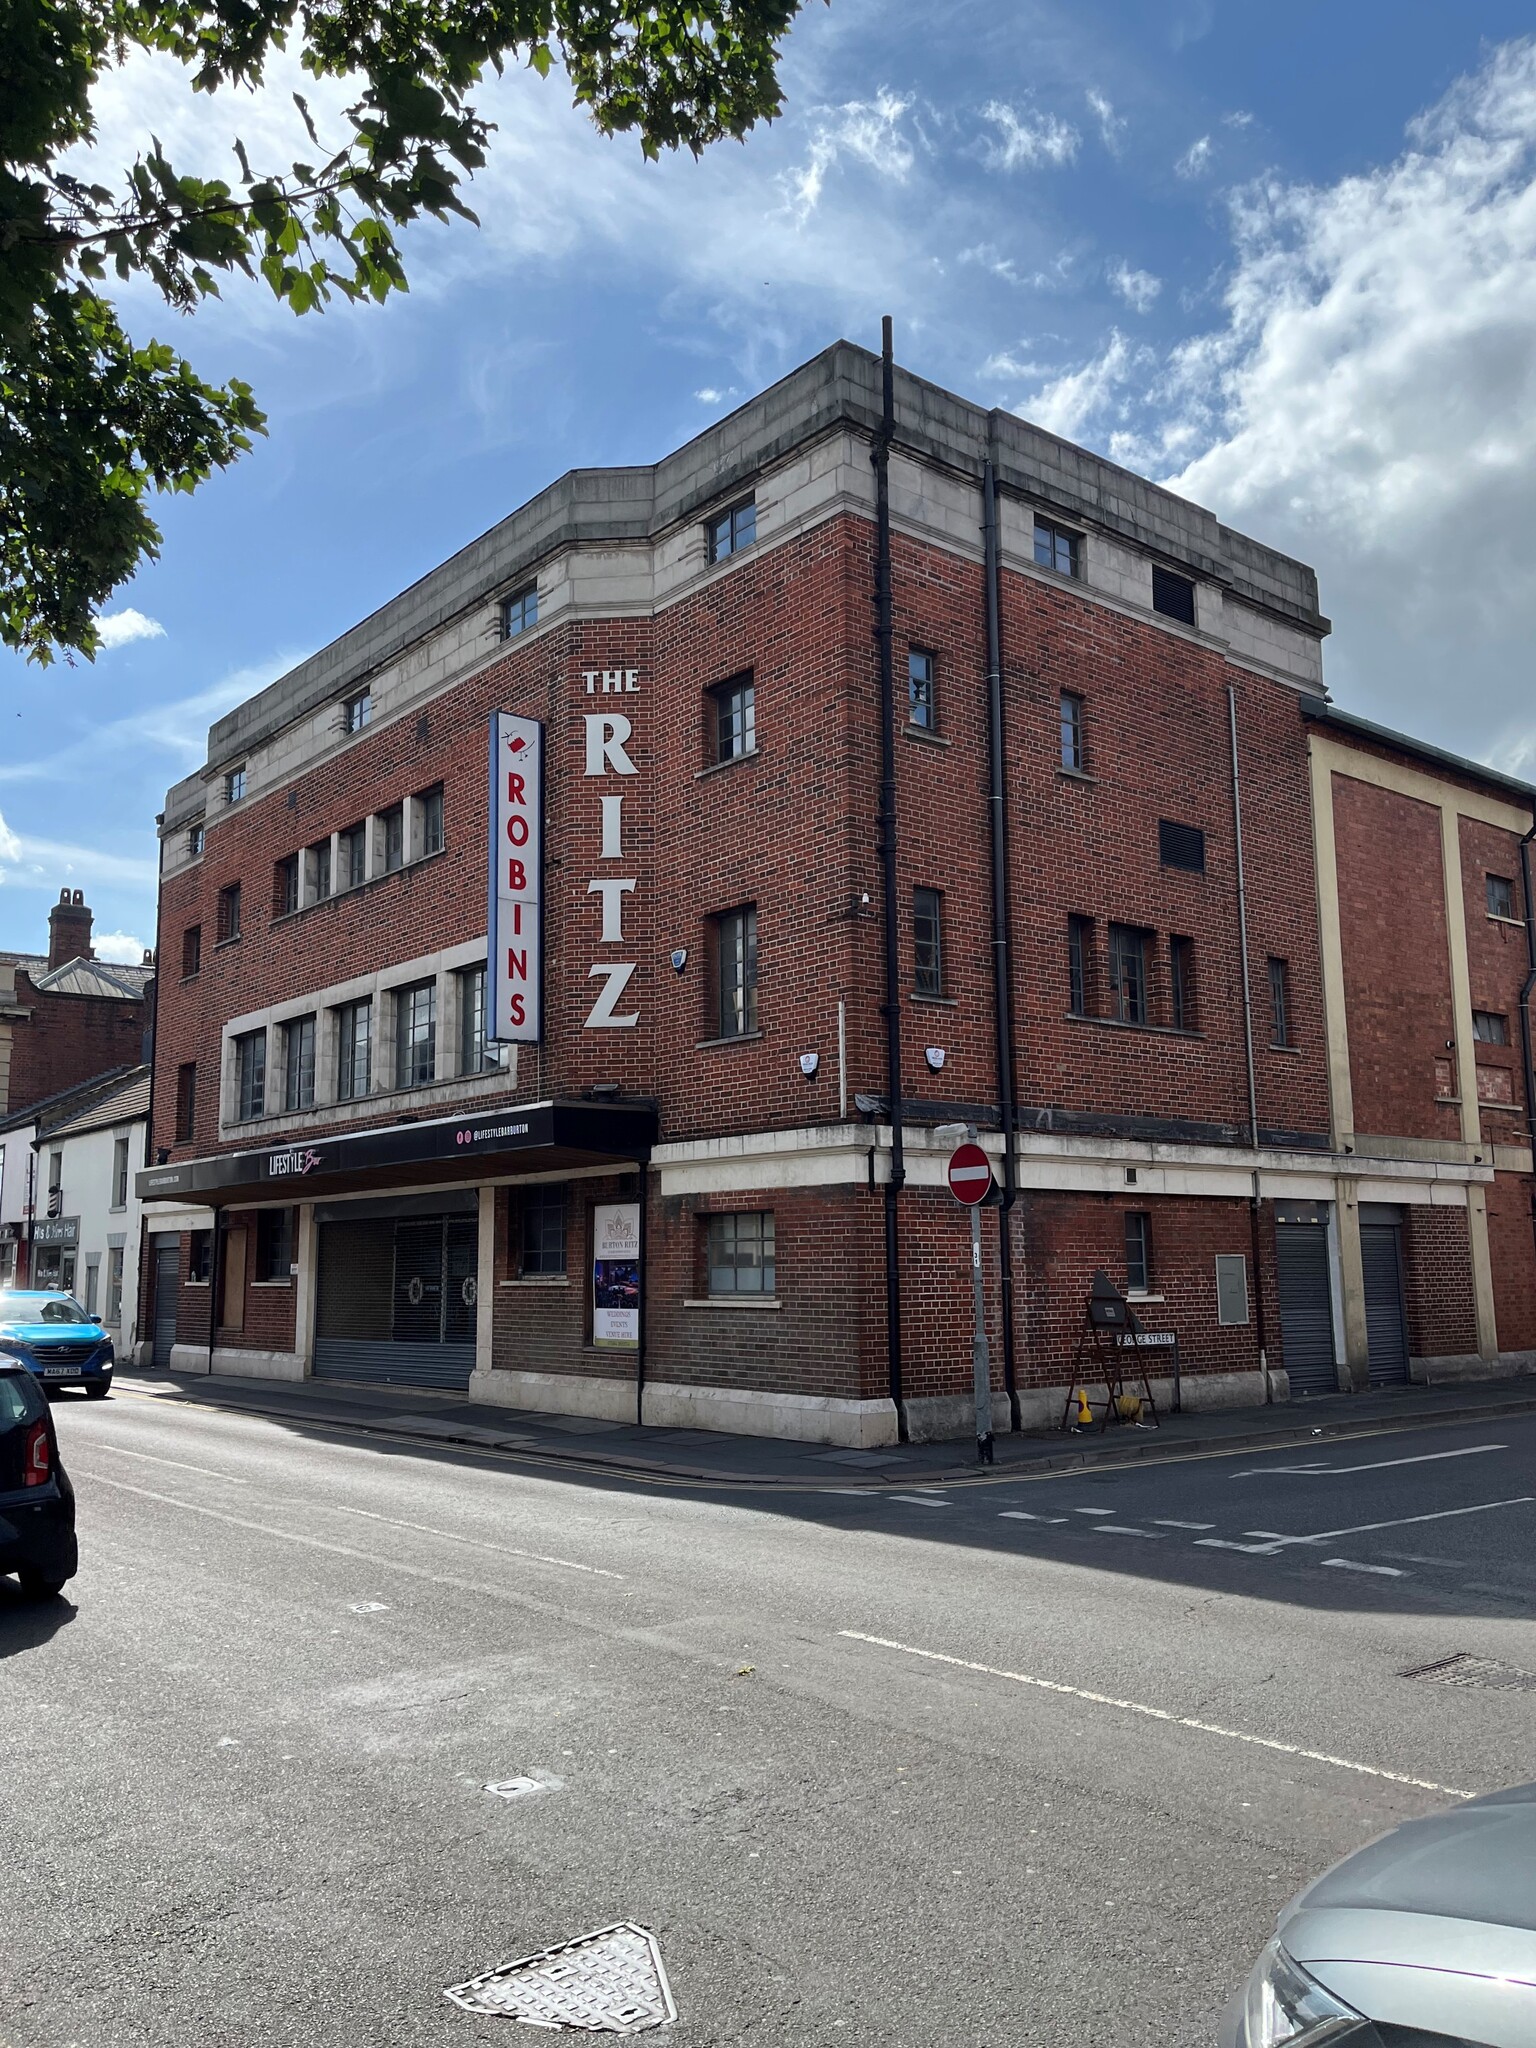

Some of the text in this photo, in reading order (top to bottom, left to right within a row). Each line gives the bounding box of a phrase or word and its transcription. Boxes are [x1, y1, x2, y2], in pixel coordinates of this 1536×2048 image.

[581, 669, 641, 694] THE
[582, 713, 641, 1029] RITZ
[506, 771, 529, 1027] ROBINS
[269, 1149, 327, 1176] LIFESTYLE Bar
[64, 1222, 76, 1238] Hair
[602, 1240, 638, 1249] BURTON RITZ
[606, 1310, 631, 1318] WEDDINGS
[610, 1320, 629, 1328] EVENTS
[620, 1331, 633, 1339] HIRE
[1117, 1333, 1174, 1345] GEOGE STREET
